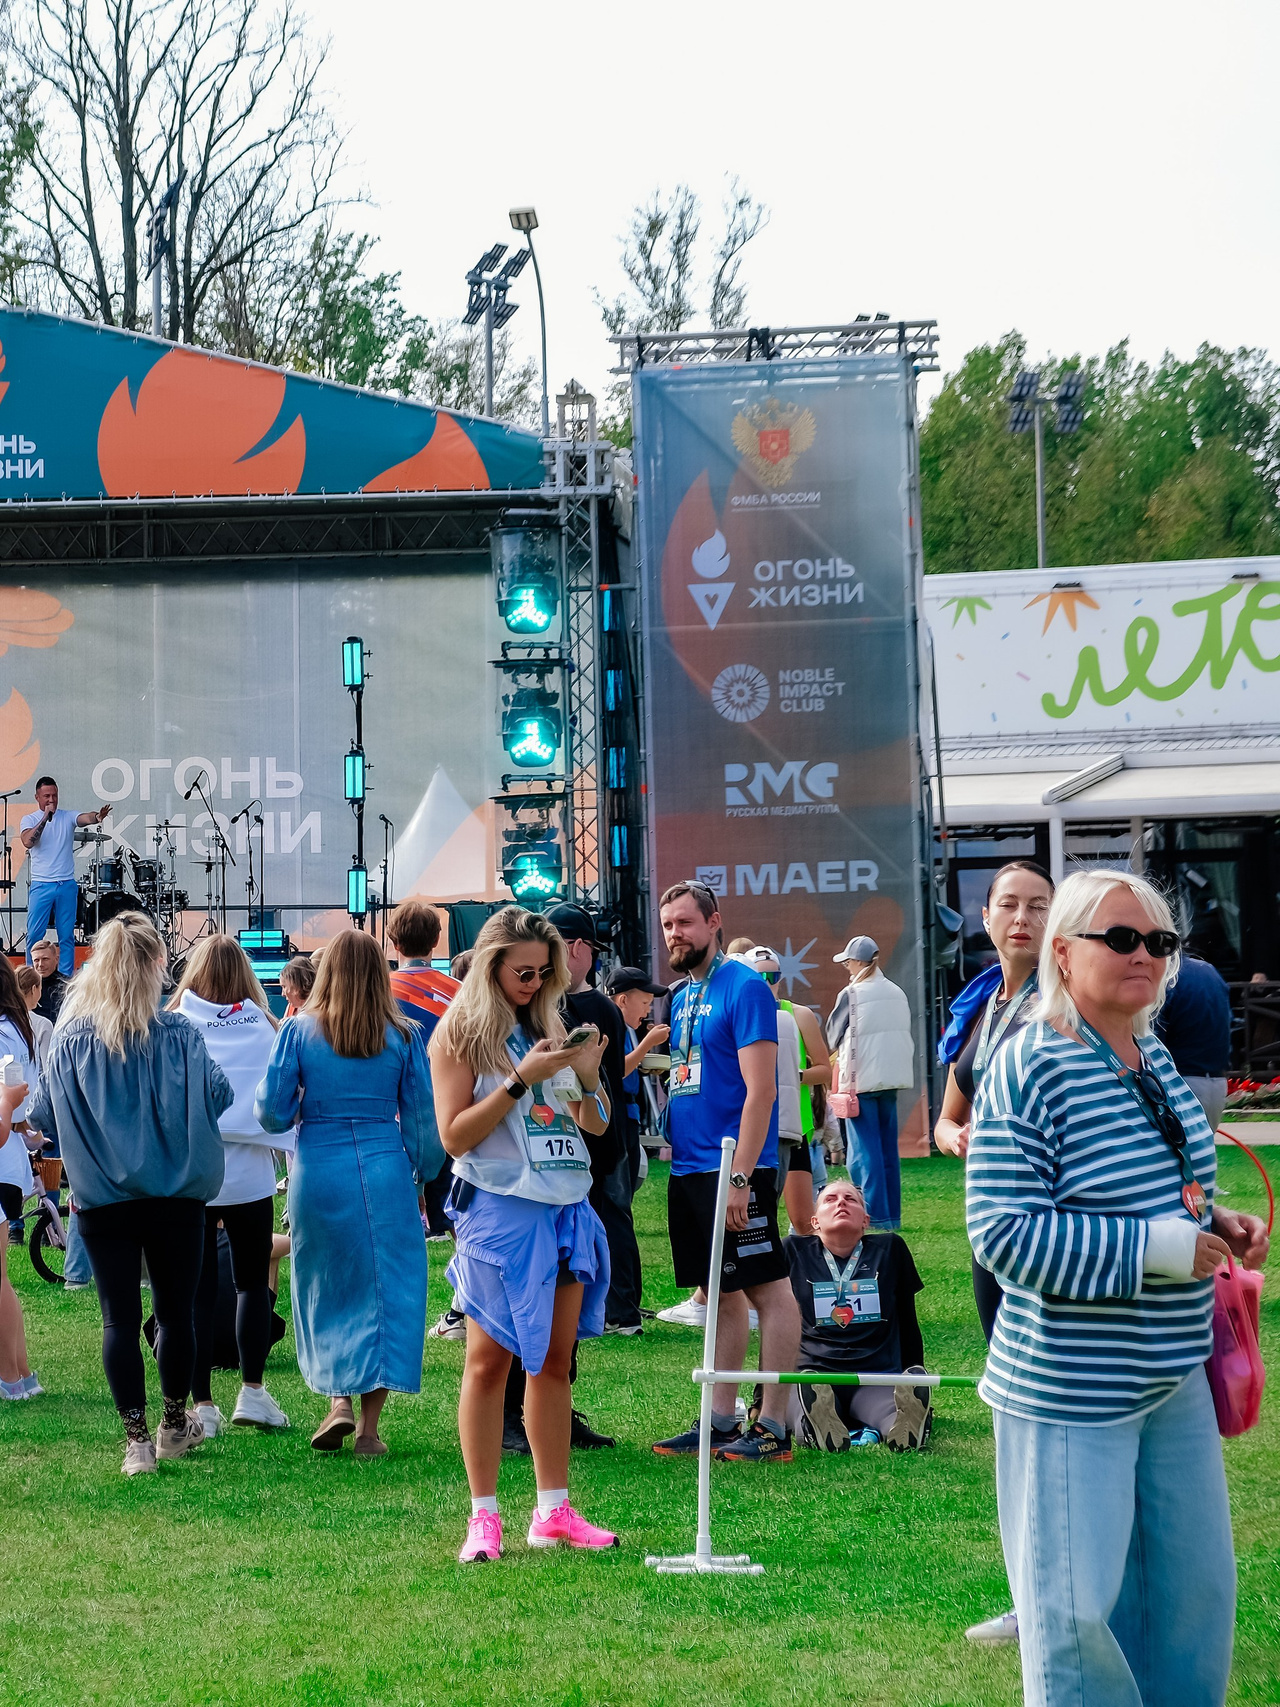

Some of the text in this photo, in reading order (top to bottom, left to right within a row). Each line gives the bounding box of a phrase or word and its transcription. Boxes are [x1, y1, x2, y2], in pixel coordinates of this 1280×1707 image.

[731, 491, 821, 506] ФМБА РОССИИ
[753, 557, 856, 582] ОГОНЬ
[747, 582, 865, 608] ЖИЗНИ
[778, 668, 835, 683] NOBLE
[779, 682, 846, 698] IMPACT
[779, 699, 826, 713] CLUB
[91, 755, 304, 802] ОГОНЬ
[724, 760, 839, 806] RMG
[725, 803, 840, 818] РУССКАЯ МЕДИАГРУППА
[735, 859, 880, 897] MAER
[207, 1016, 259, 1028] РОСКОСМОС
[545, 1139, 575, 1157] 176
[758, 1441, 778, 1453] HOKA
